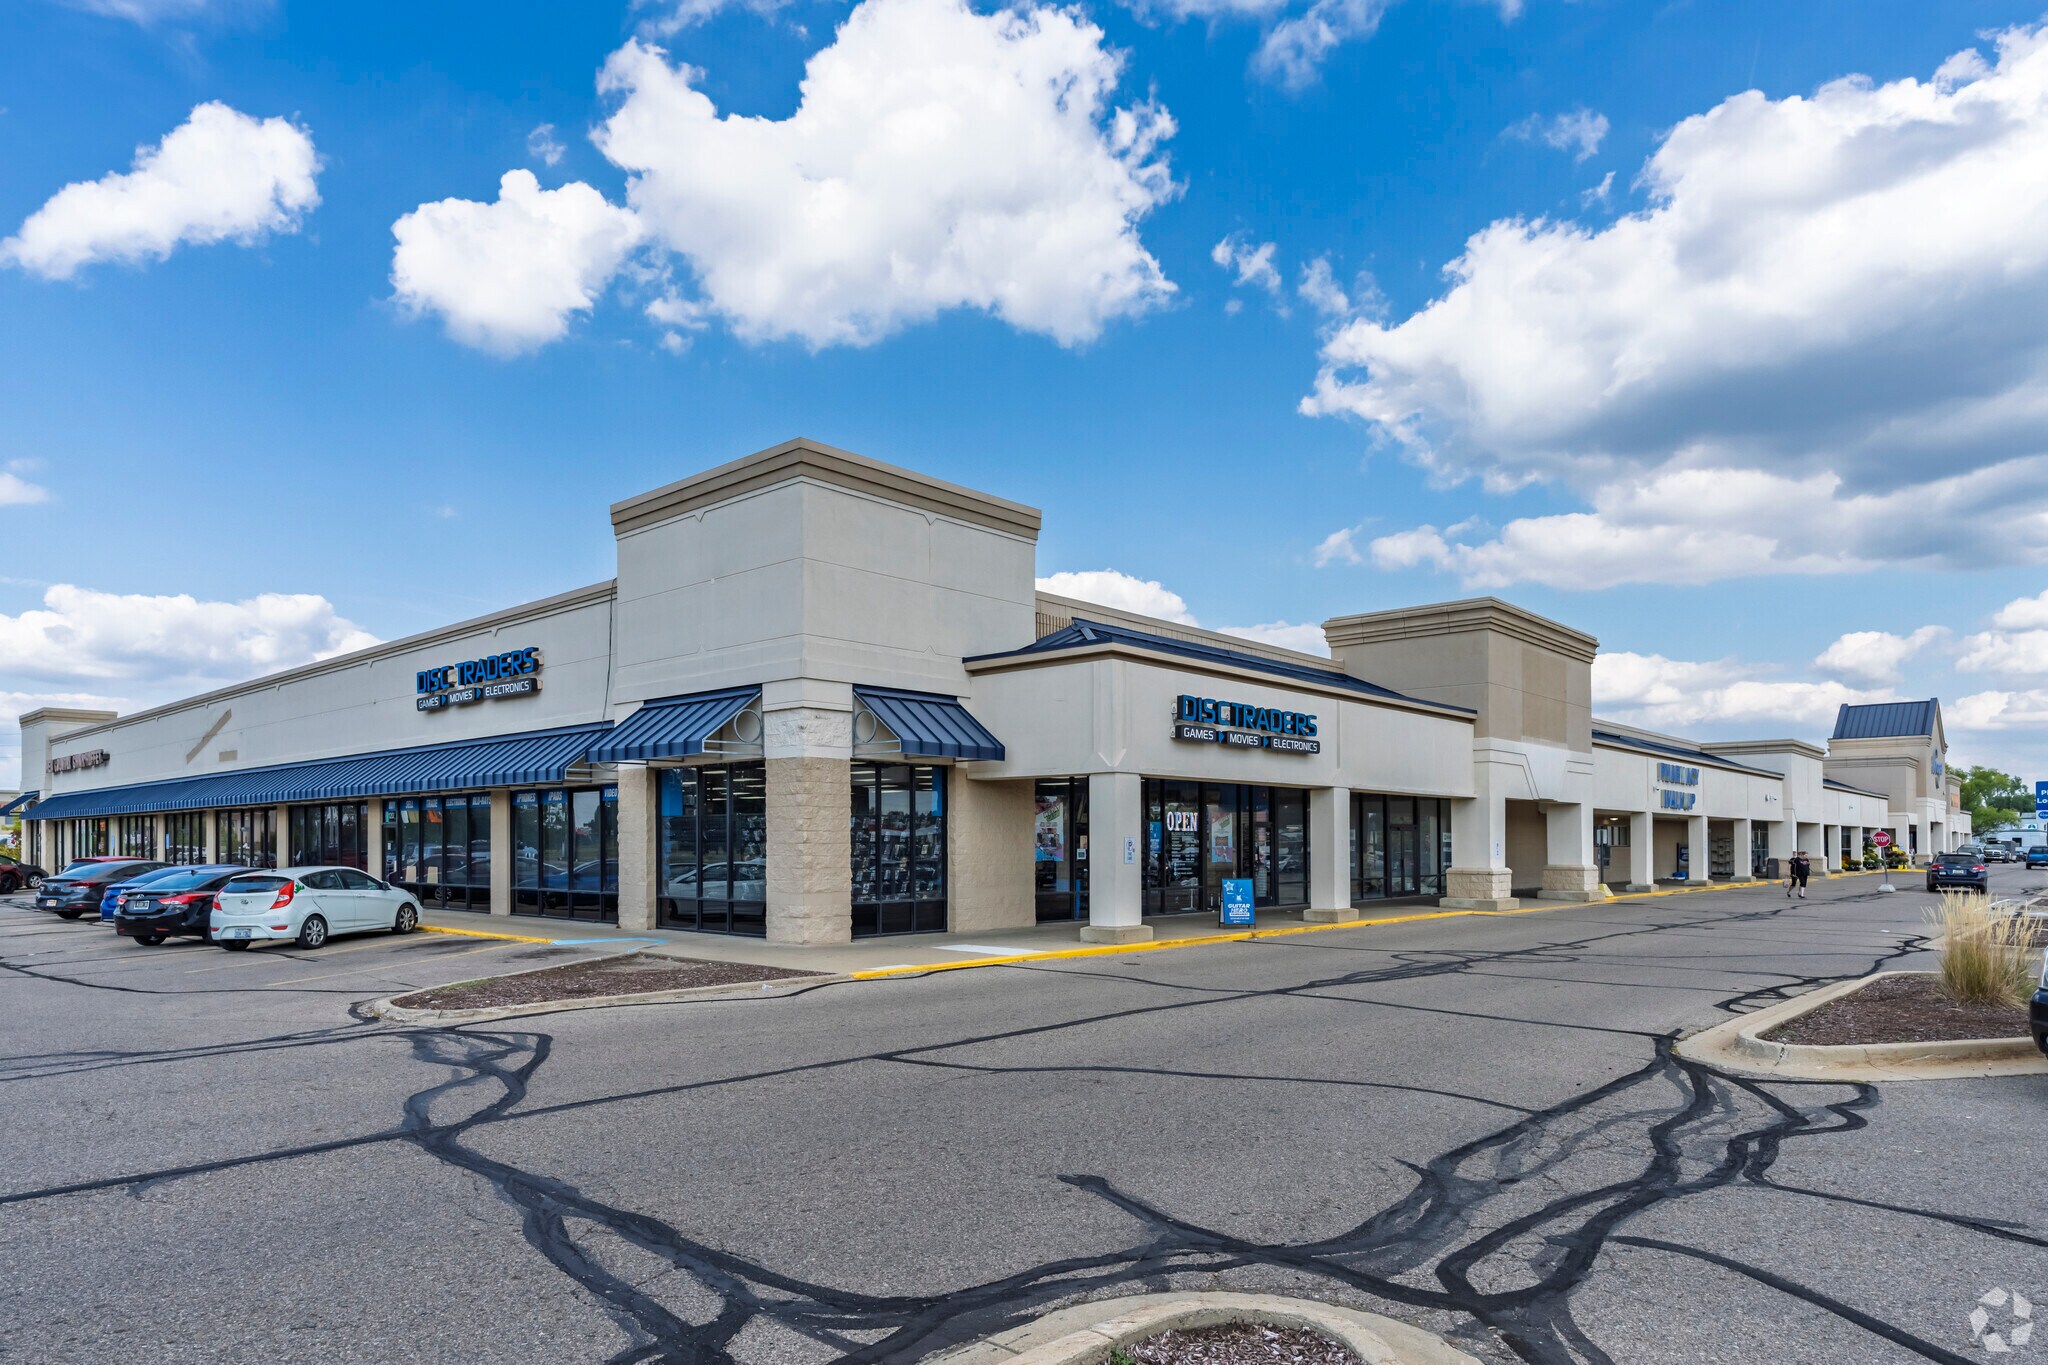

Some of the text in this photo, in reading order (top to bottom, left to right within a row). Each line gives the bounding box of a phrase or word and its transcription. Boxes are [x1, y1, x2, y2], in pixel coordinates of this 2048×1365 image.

[417, 647, 539, 694] DISC TRADERS
[419, 680, 530, 708] GAMES MOVIES ELECTRONICS
[1180, 694, 1318, 737] DISC TRADERS
[1183, 727, 1318, 752] GAMES MOVIES ELECTRONICS
[1166, 811, 1199, 831] OPEN
